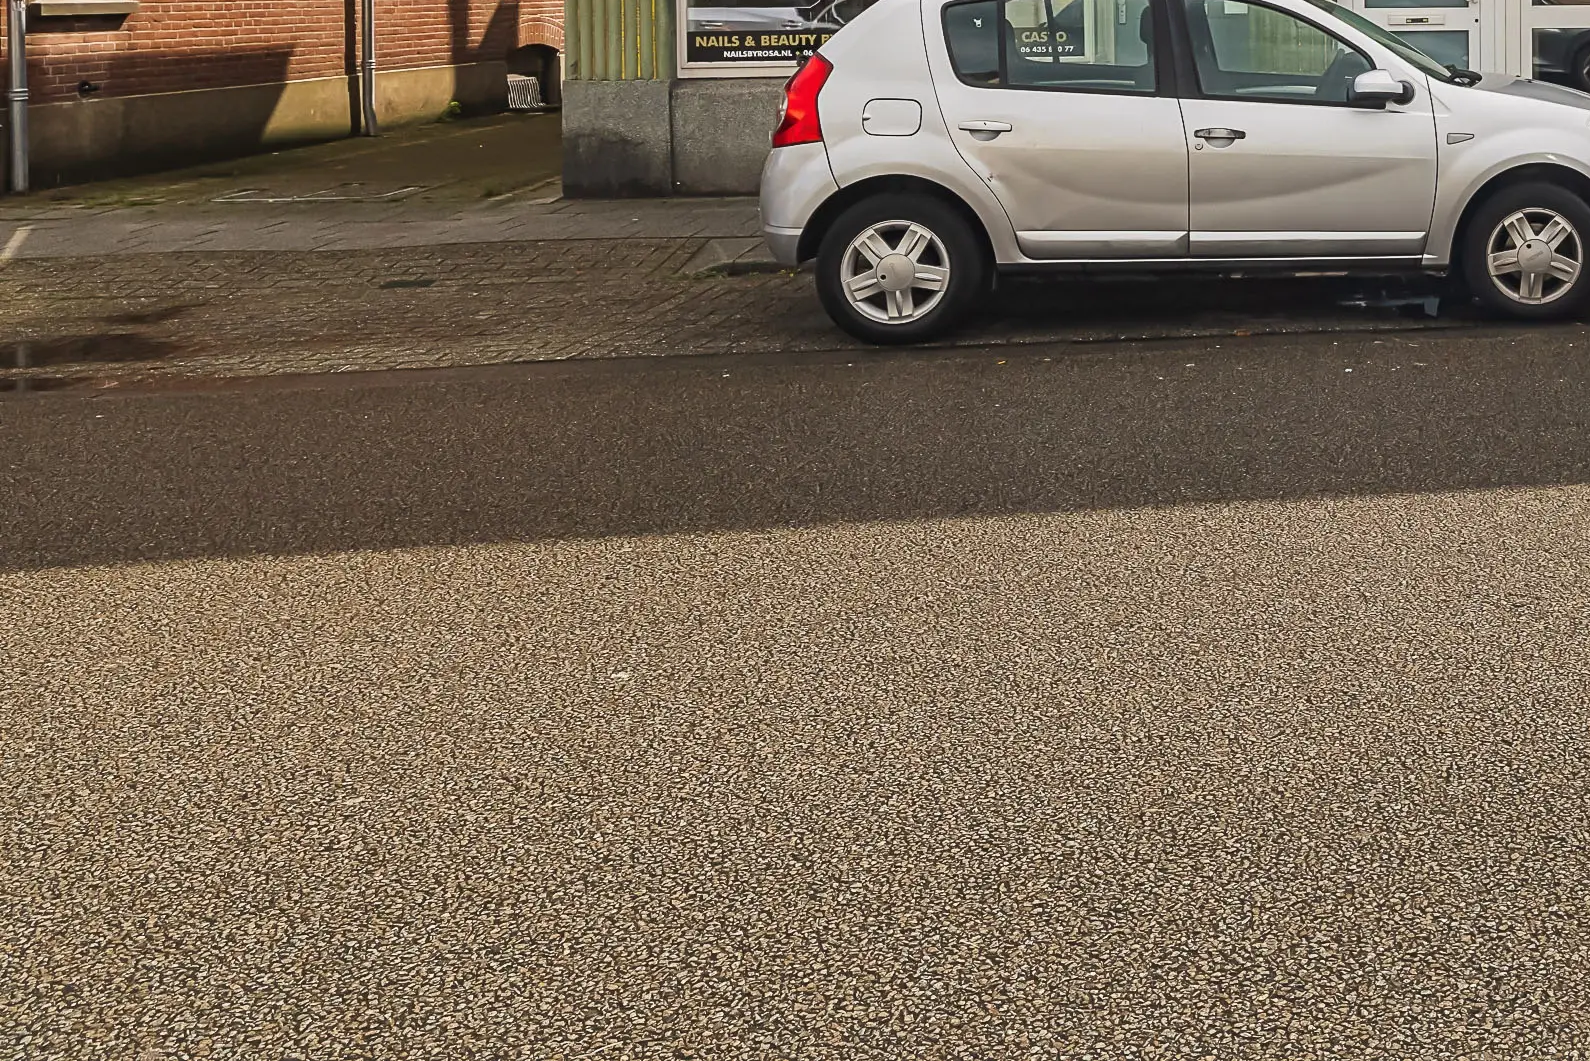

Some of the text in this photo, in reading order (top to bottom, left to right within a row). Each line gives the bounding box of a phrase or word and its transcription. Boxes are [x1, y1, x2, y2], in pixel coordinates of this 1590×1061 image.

[695, 35, 740, 47] NAILS
[744, 35, 756, 47] &
[761, 34, 817, 46] BEAUTY
[1021, 31, 1067, 43] CASO
[723, 49, 793, 58] NAILSBYROSA.NL
[1064, 45, 1075, 53] 77
